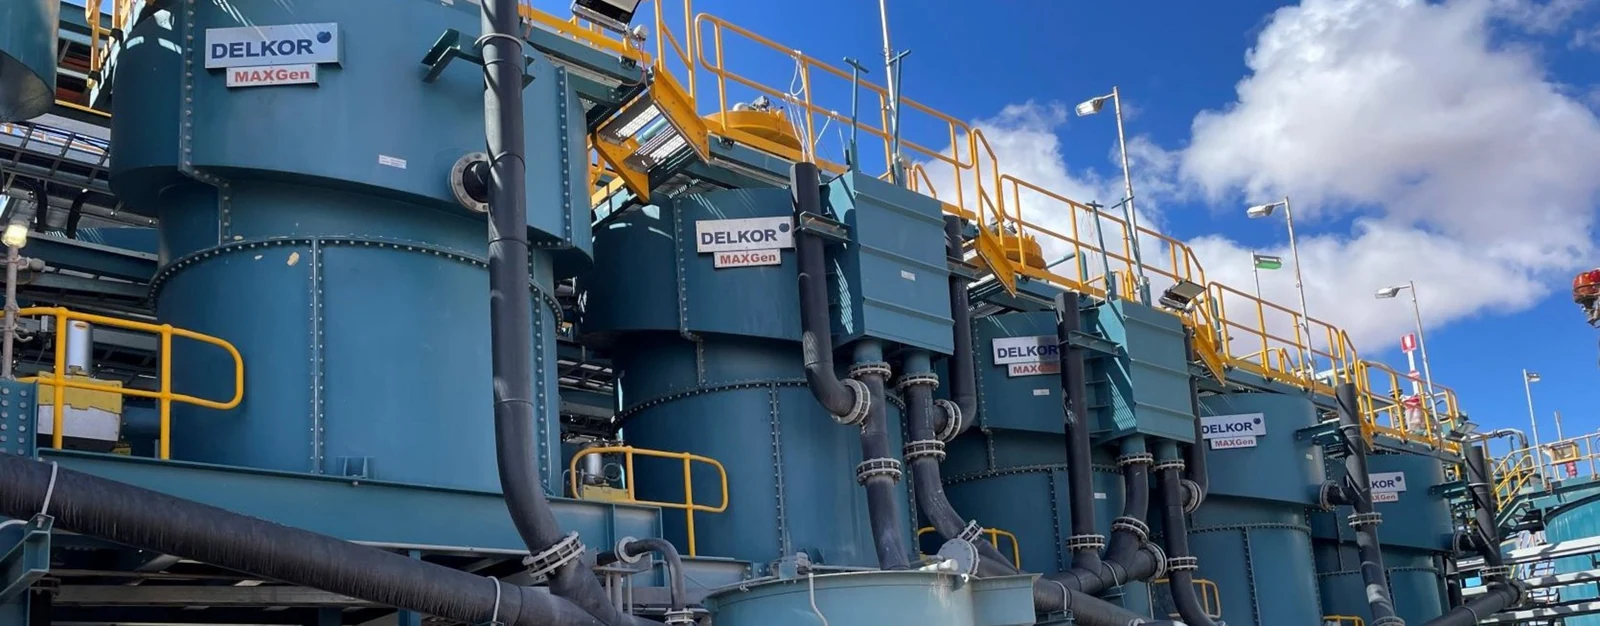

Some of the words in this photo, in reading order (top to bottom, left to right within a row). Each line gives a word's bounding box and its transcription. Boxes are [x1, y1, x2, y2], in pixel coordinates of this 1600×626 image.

[212, 39, 314, 59] DELKOR
[234, 69, 310, 83] MAXGen
[701, 229, 778, 245] DELKOR
[720, 253, 776, 265] MAXGen
[997, 345, 1059, 359] DELKOR
[1201, 422, 1254, 434] DELKOR
[1215, 438, 1254, 447] MAXGen
[1371, 480, 1396, 489] KOR
